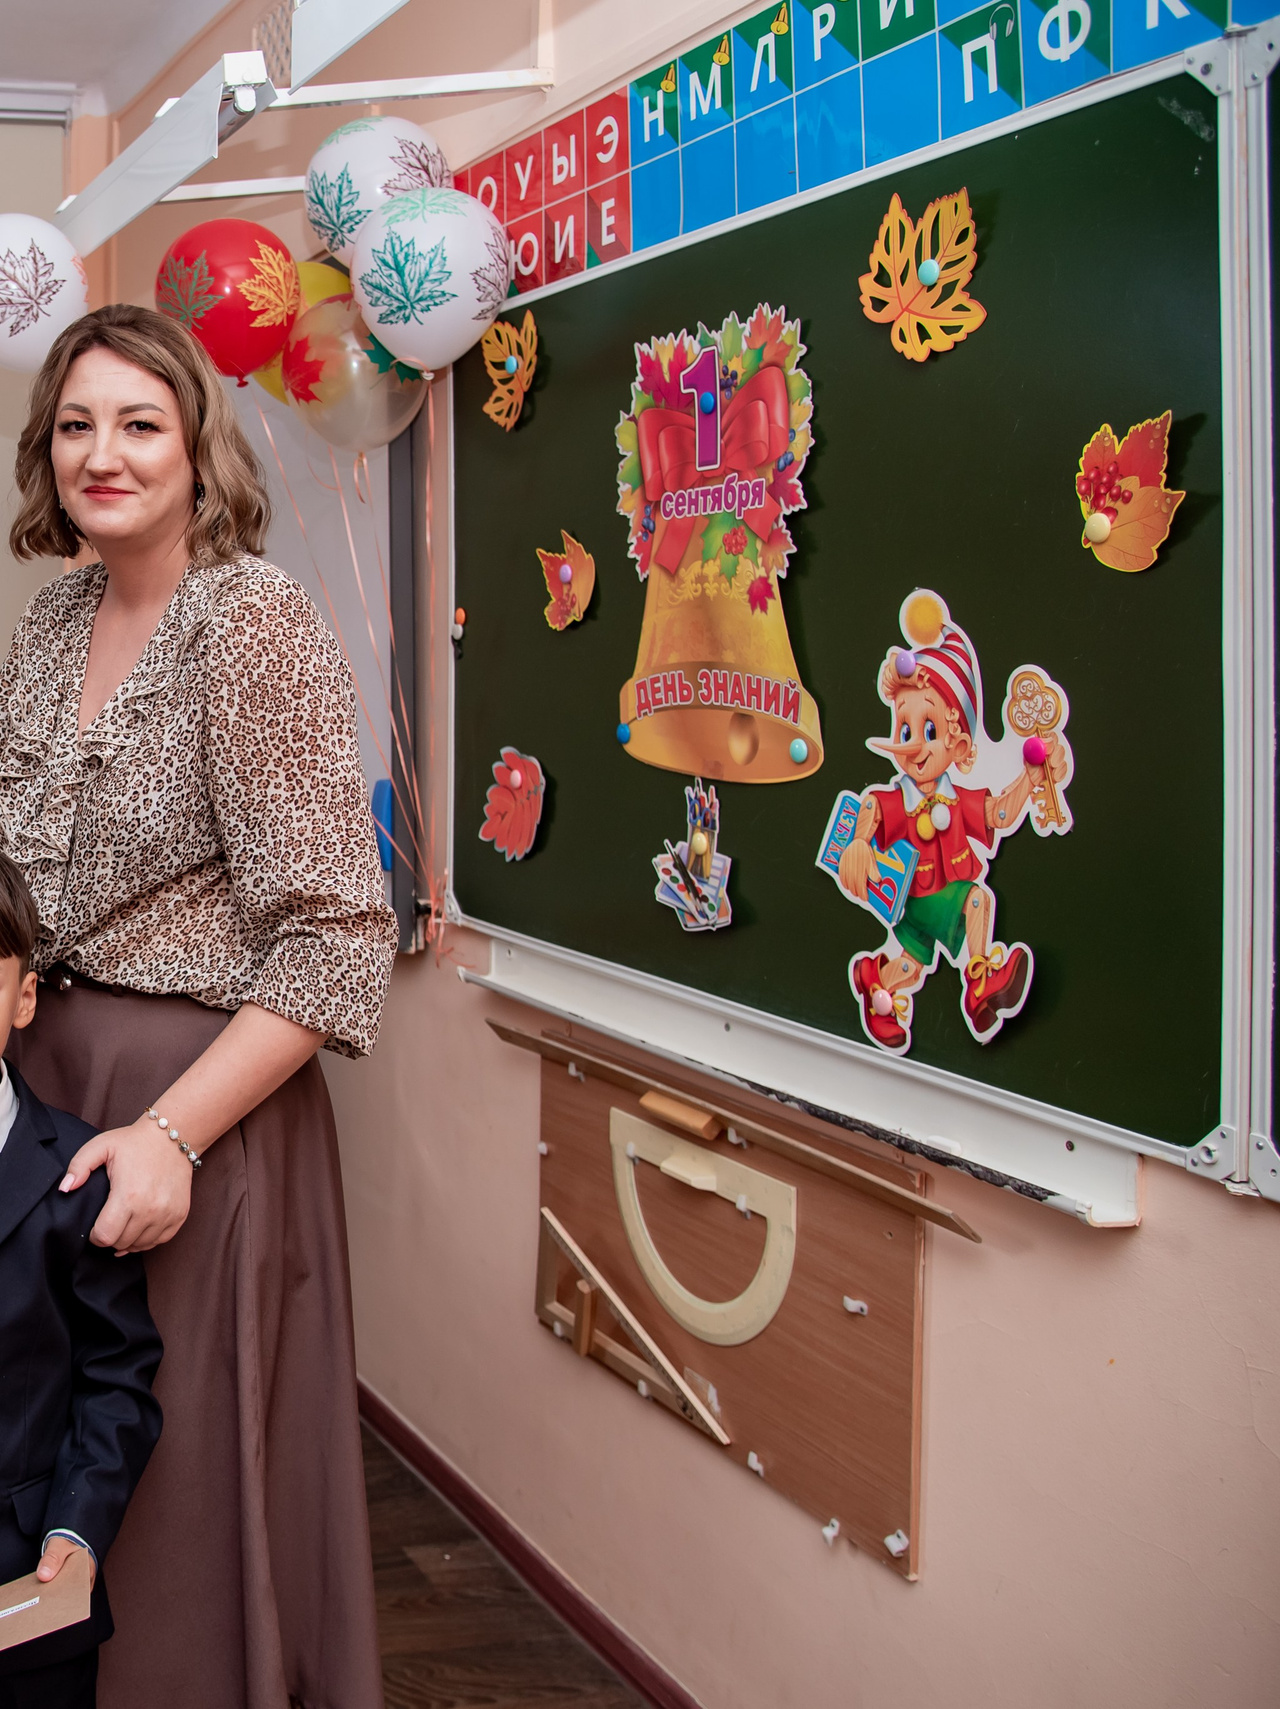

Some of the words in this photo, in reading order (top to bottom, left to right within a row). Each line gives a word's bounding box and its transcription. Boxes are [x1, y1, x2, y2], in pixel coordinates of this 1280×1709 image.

[514, 155, 533, 201] У
[552, 134, 576, 185] Ы
[596, 115, 619, 163] Э
[643, 90, 664, 143] Н
[689, 62, 722, 121] М
[750, 32, 776, 93] Л
[813, 3, 836, 62] Р
[555, 214, 574, 264] И
[601, 198, 616, 247] Е
[961, 33, 998, 104] П
[1038, 0, 1091, 63] Ф
[680, 346, 720, 471] 1
[661, 473, 765, 519] сентября
[634, 669, 694, 719] ДЕНЬ
[698, 668, 801, 724] ЗНАНИЙ
[824, 801, 858, 866] АЗБУКА
